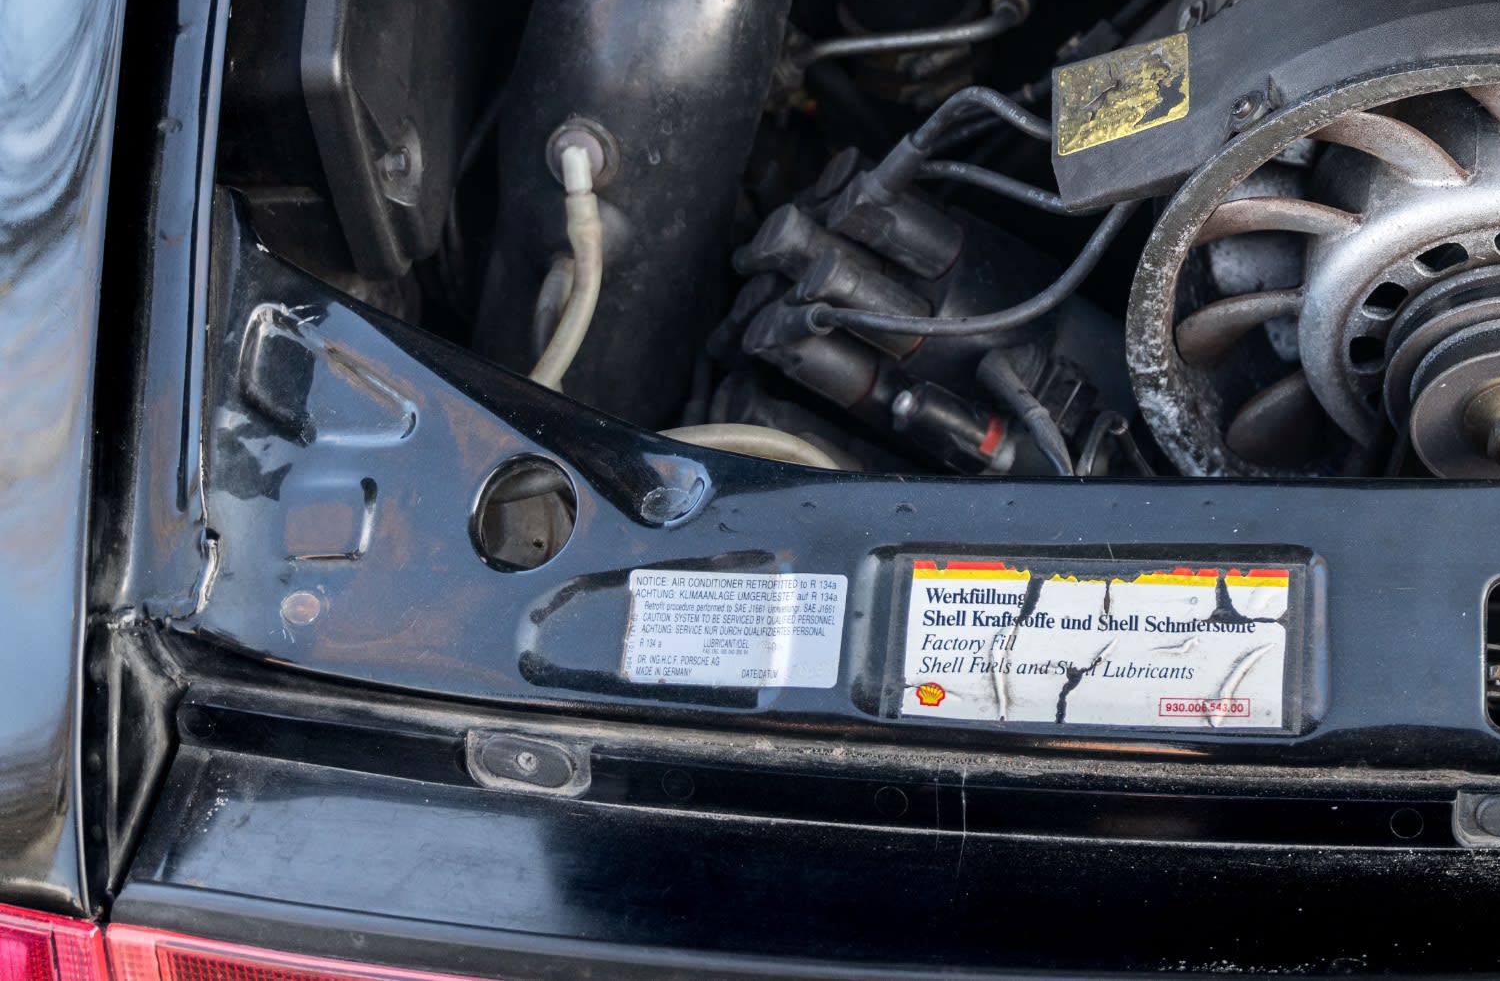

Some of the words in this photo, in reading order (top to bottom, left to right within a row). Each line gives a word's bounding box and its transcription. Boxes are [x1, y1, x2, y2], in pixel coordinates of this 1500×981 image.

[671, 577, 686, 587] AIR
[688, 577, 744, 589] CONDITIONER
[746, 579, 798, 590] RETROFITTED
[800, 580, 808, 590] to
[810, 580, 817, 589] R
[820, 580, 838, 590] 134a
[679, 590, 735, 601] KLIMAANLAGE
[737, 591, 795, 602] UMGERUESTET
[797, 592, 809, 601] auf
[811, 592, 818, 601] R
[821, 592, 839, 602] 134a
[926, 587, 1027, 608] Werkfüllung
[644, 601, 665, 611] Retrofit
[667, 602, 695, 613] procedure
[734, 603, 748, 613] SAE
[803, 604, 817, 614] SAE
[674, 613, 700, 623] SYSTEM
[702, 614, 711, 624] TO
[712, 614, 721, 624] BE
[722, 615, 755, 625] SERVICED
[756, 615, 765, 625] BY
[798, 616, 836, 626] PERSONNEL
[922, 609, 967, 627] Shell
[1060, 614, 1093, 631] und
[1097, 614, 1139, 632] Shell
[675, 625, 703, 635] SERVICE
[704, 626, 719, 636] NUR
[719, 626, 743, 636] DURCH
[792, 627, 826, 637] PERSONAL
[921, 633, 986, 655] Factory
[990, 634, 1018, 652] Fill
[680, 656, 709, 667] PORSCHE
[635, 667, 653, 677] MADE
[663, 667, 693, 677] GERMANY
[918, 656, 965, 674] Shell
[968, 656, 1013, 675] Fuels
[1016, 660, 1051, 675] and
[1103, 661, 1195, 680] Lubricants
